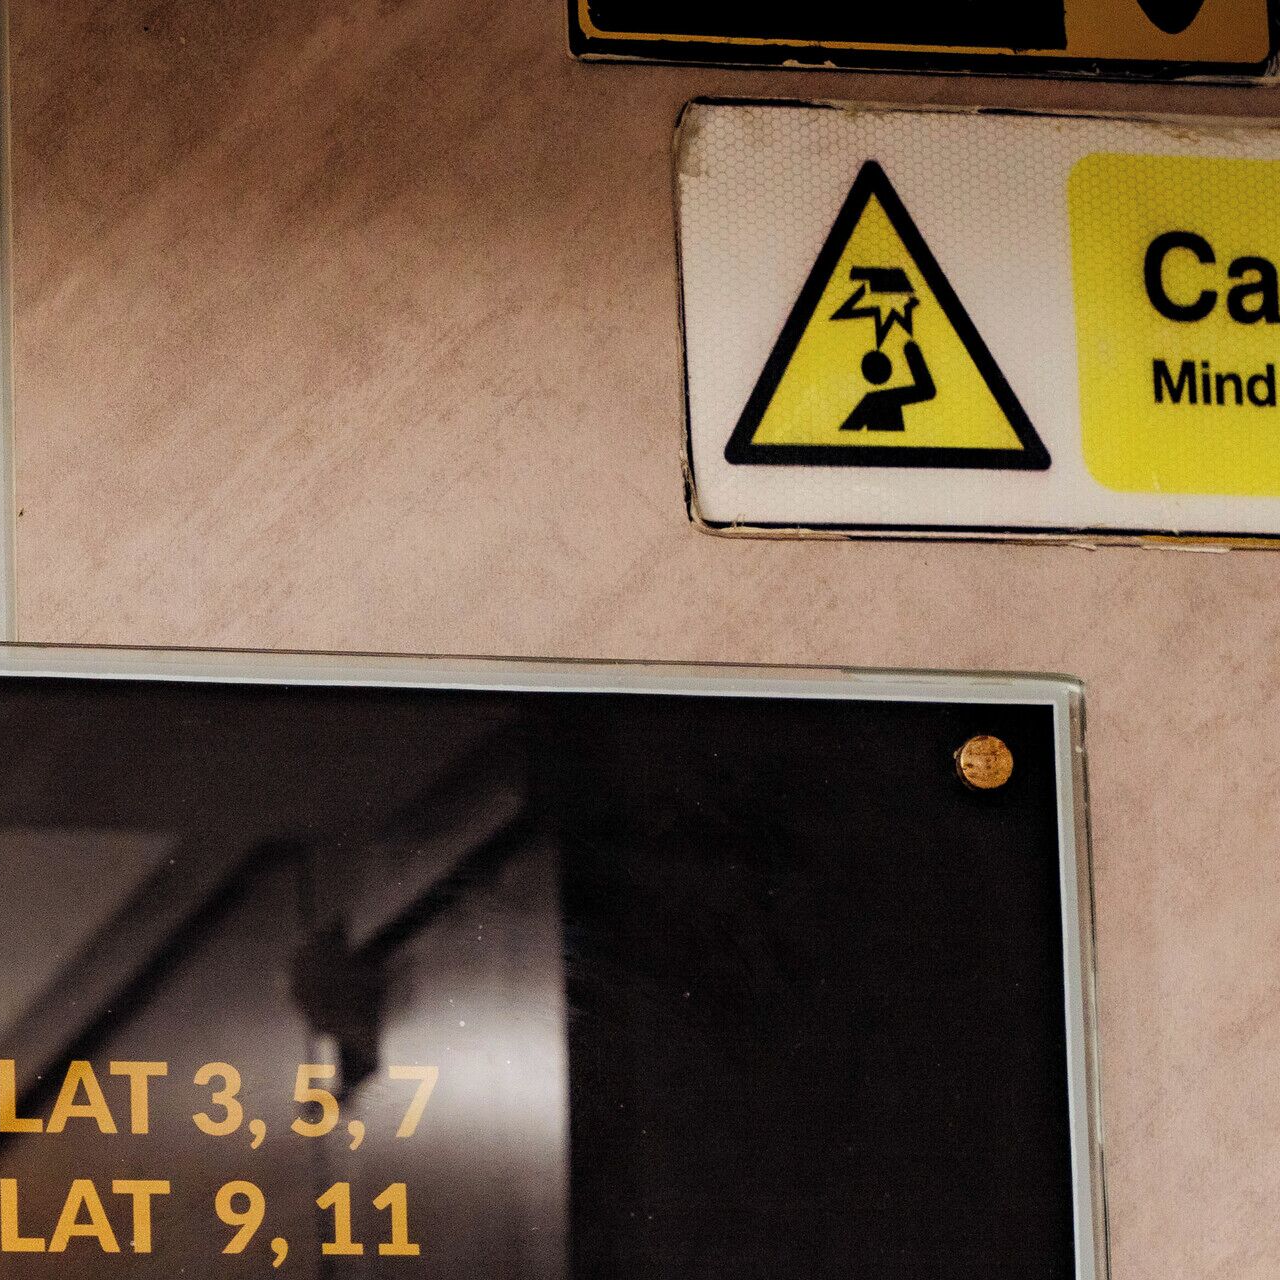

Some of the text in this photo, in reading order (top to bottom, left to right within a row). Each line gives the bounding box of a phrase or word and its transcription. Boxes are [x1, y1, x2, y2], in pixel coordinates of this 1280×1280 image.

[1152, 358, 1277, 407] Mind
[192, 1061, 267, 1150] 3,
[290, 1064, 366, 1150] 5,
[387, 1065, 441, 1139] 7
[214, 1180, 289, 1268] 9,
[315, 1181, 420, 1256] 11
